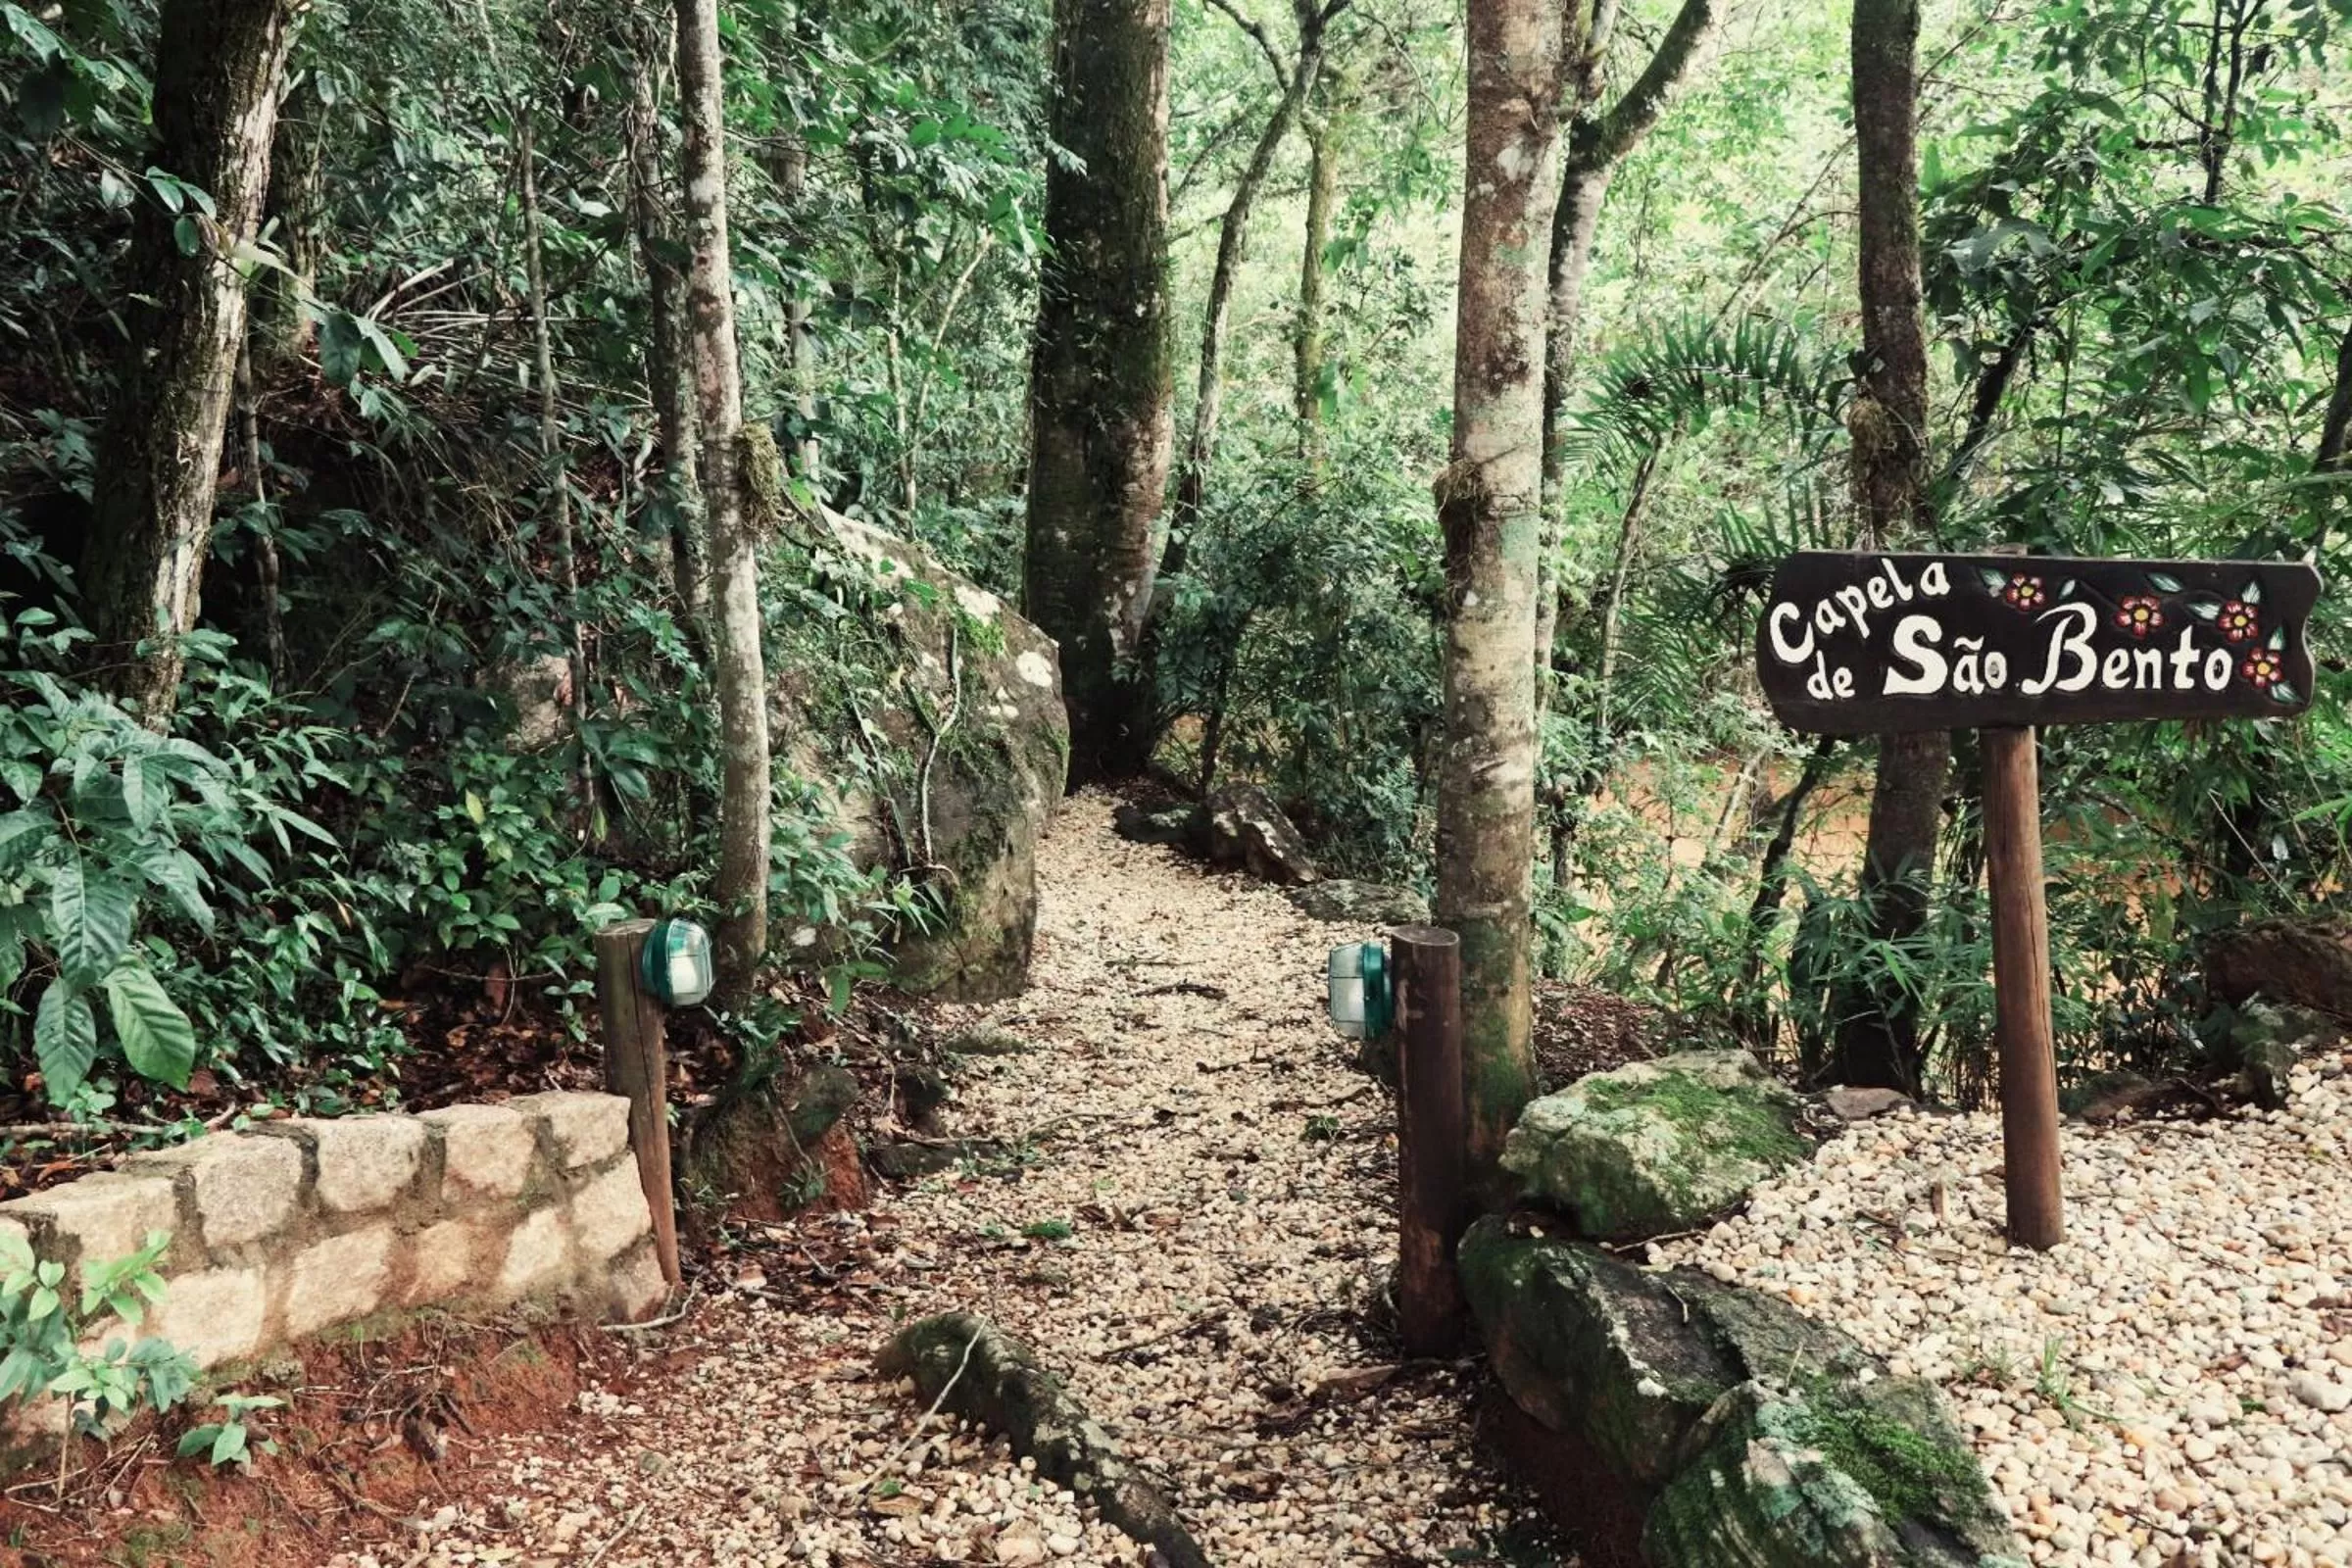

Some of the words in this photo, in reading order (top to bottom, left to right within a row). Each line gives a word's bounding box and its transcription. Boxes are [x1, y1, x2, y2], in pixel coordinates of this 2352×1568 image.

[1769, 558, 1951, 663] Capela
[1806, 650, 1855, 701] de
[1883, 614, 2008, 695] São
[2021, 602, 2233, 695] Bento
